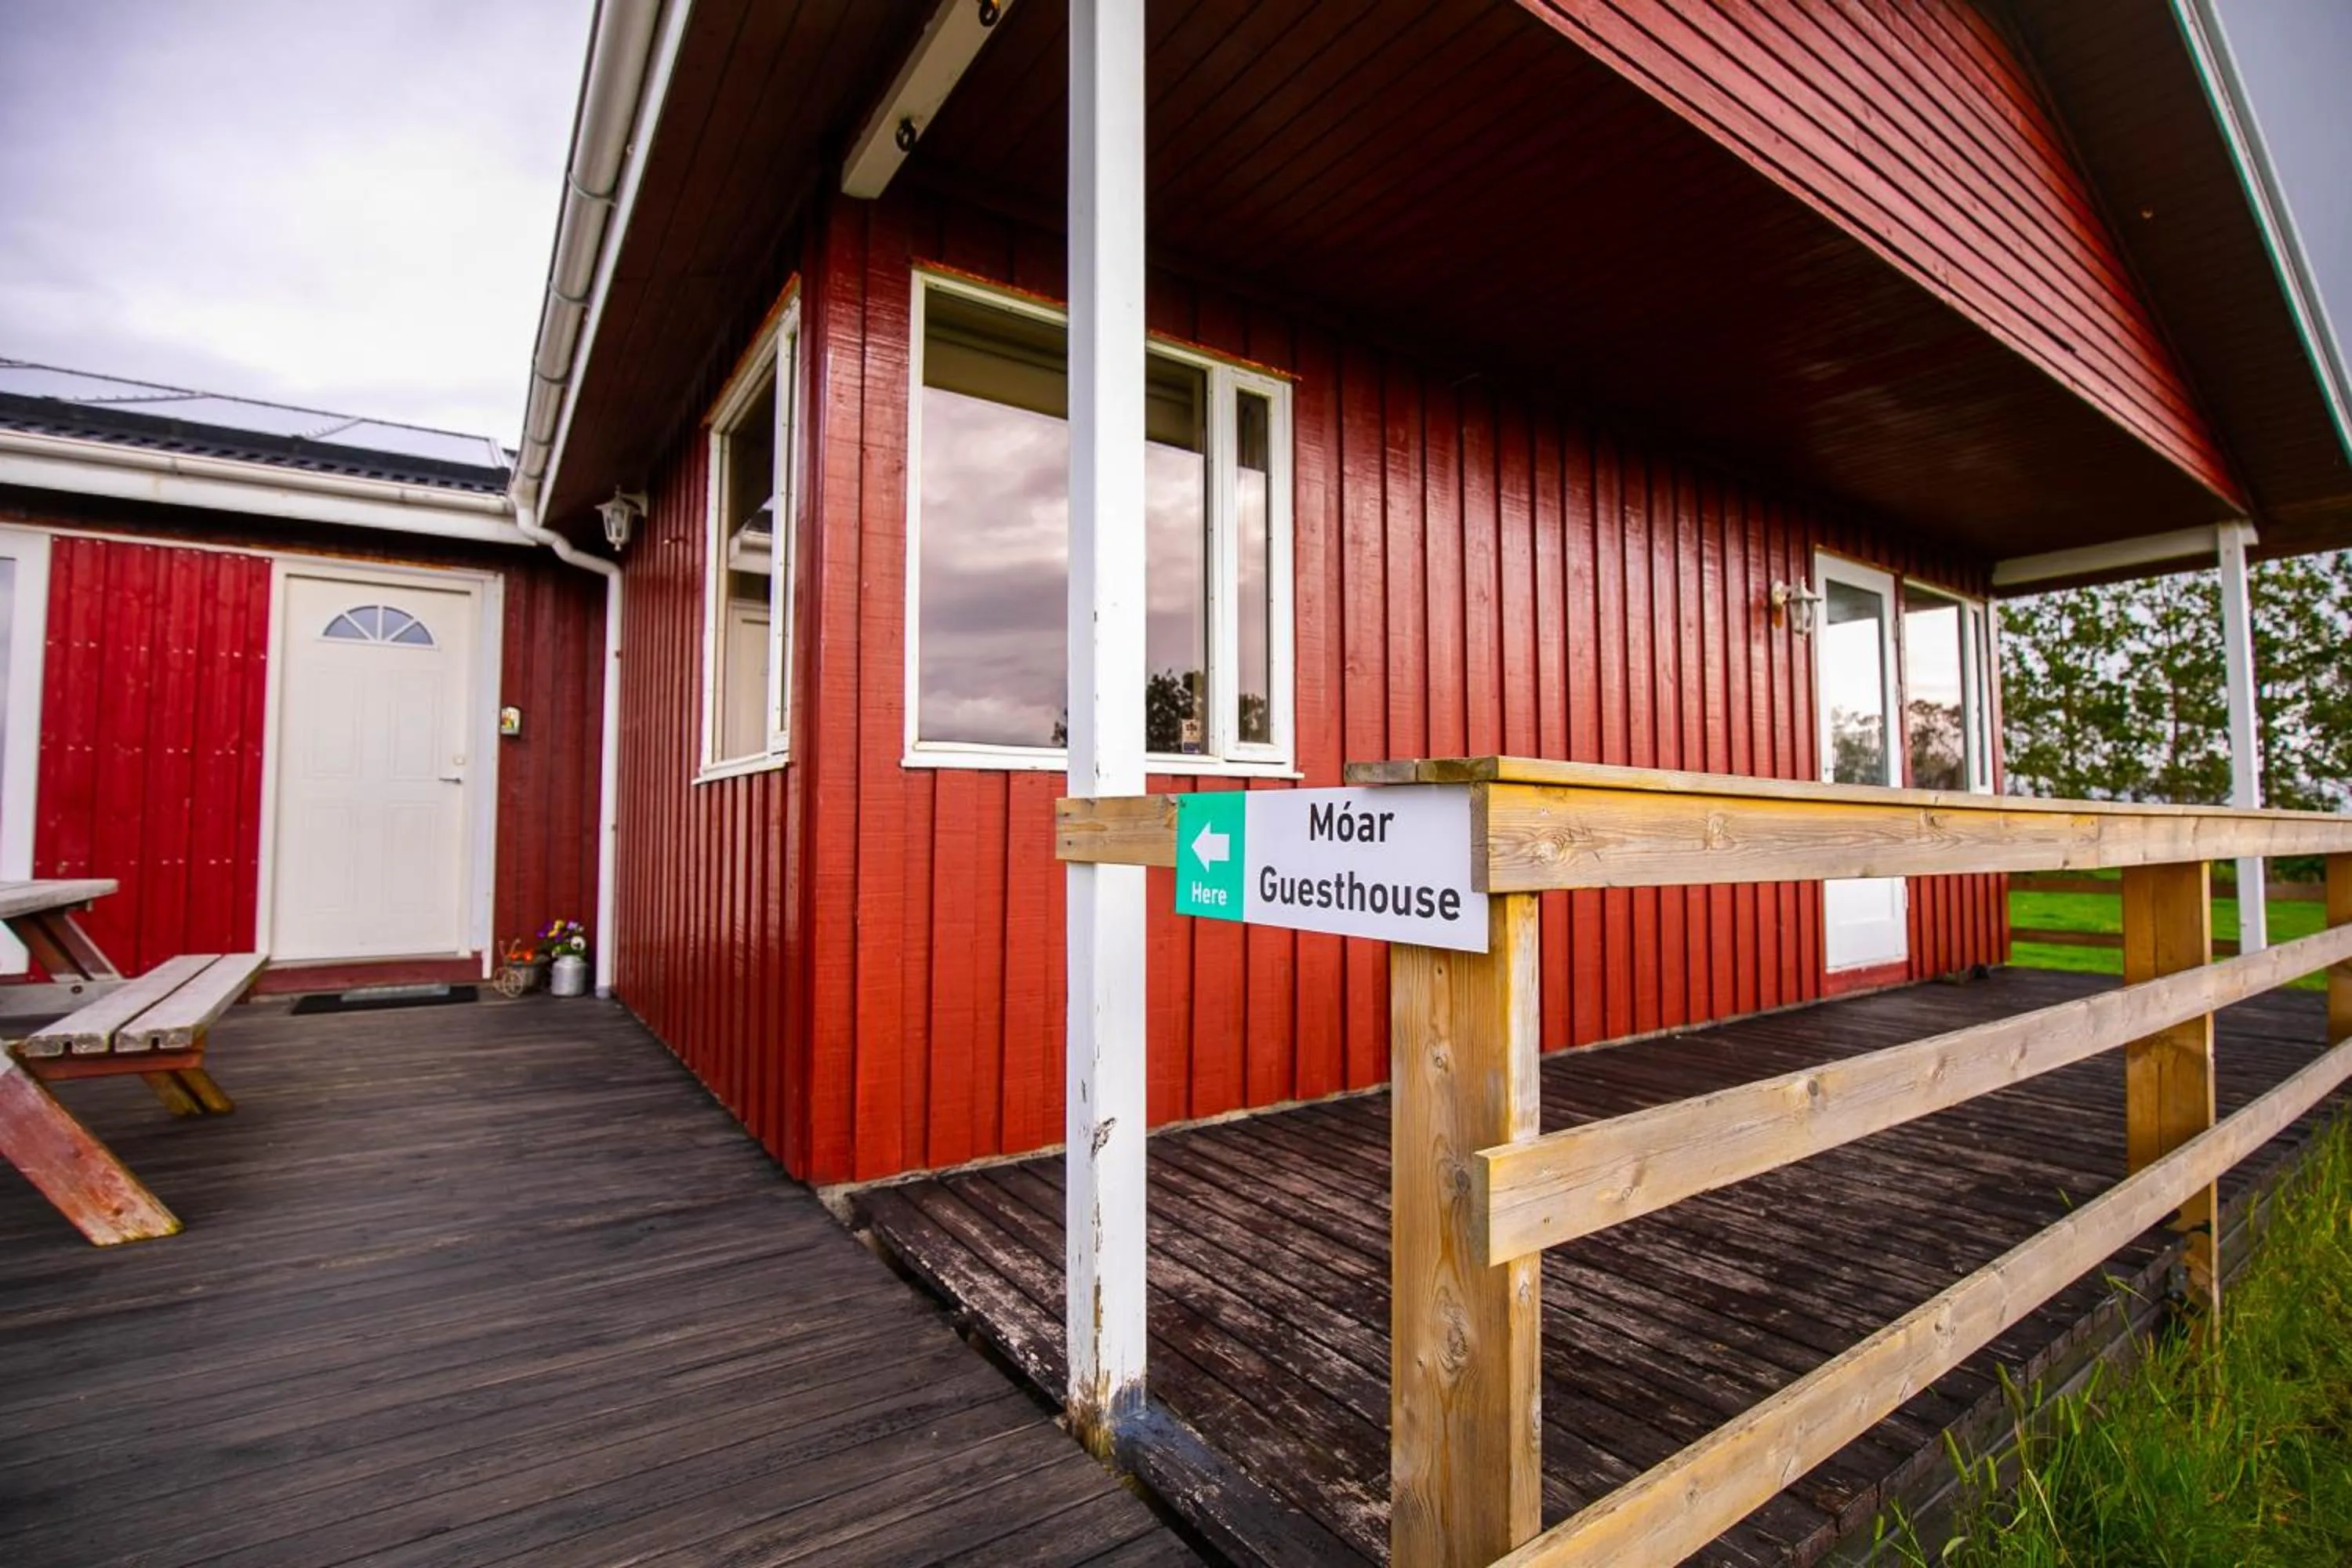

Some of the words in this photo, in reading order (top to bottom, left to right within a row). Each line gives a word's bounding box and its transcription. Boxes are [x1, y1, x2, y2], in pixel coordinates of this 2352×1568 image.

[1309, 801, 1394, 843] Móar
[1192, 881, 1227, 905] Here
[1260, 866, 1461, 920] Guesthouse
